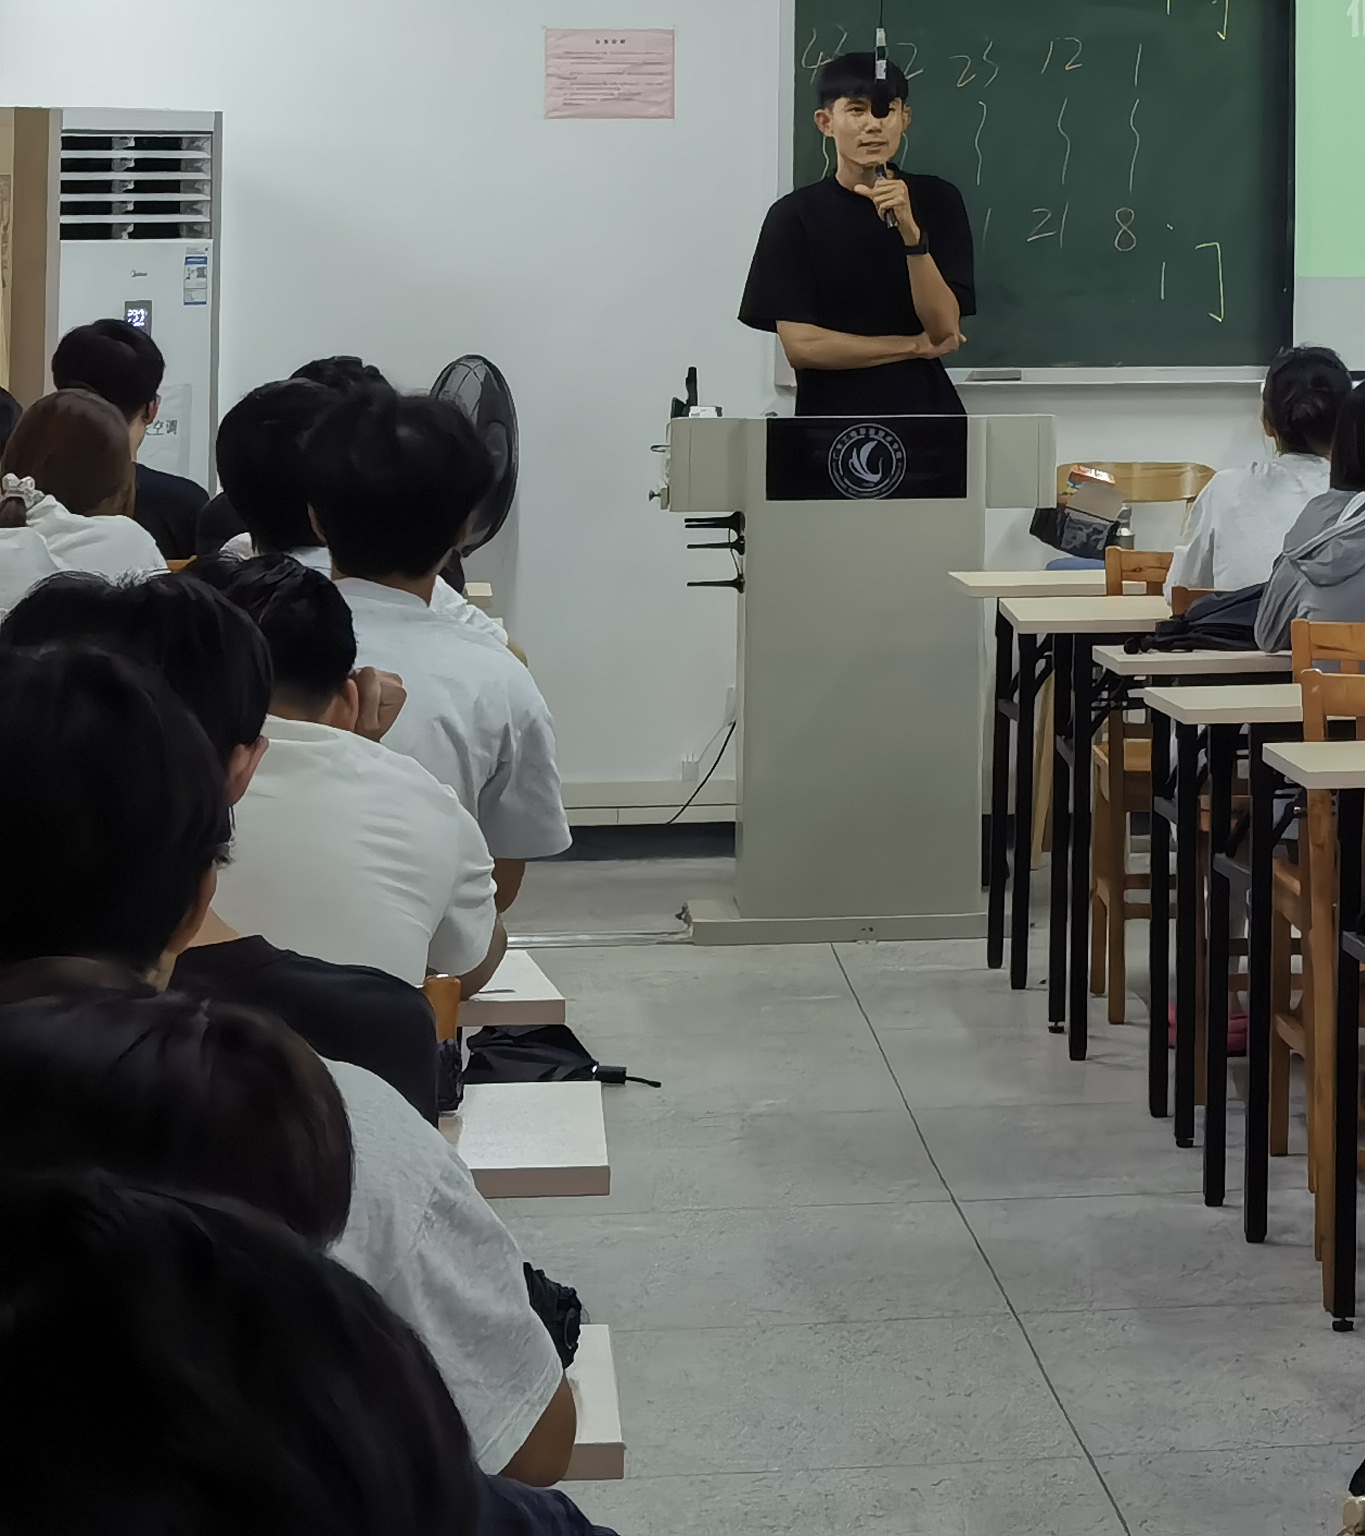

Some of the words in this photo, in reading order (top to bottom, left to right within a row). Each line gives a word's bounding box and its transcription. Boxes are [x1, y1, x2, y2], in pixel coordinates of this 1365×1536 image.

[1041, 36, 1083, 75] 12
[1026, 201, 1069, 249] 21
[1114, 206, 1137, 252] 8
